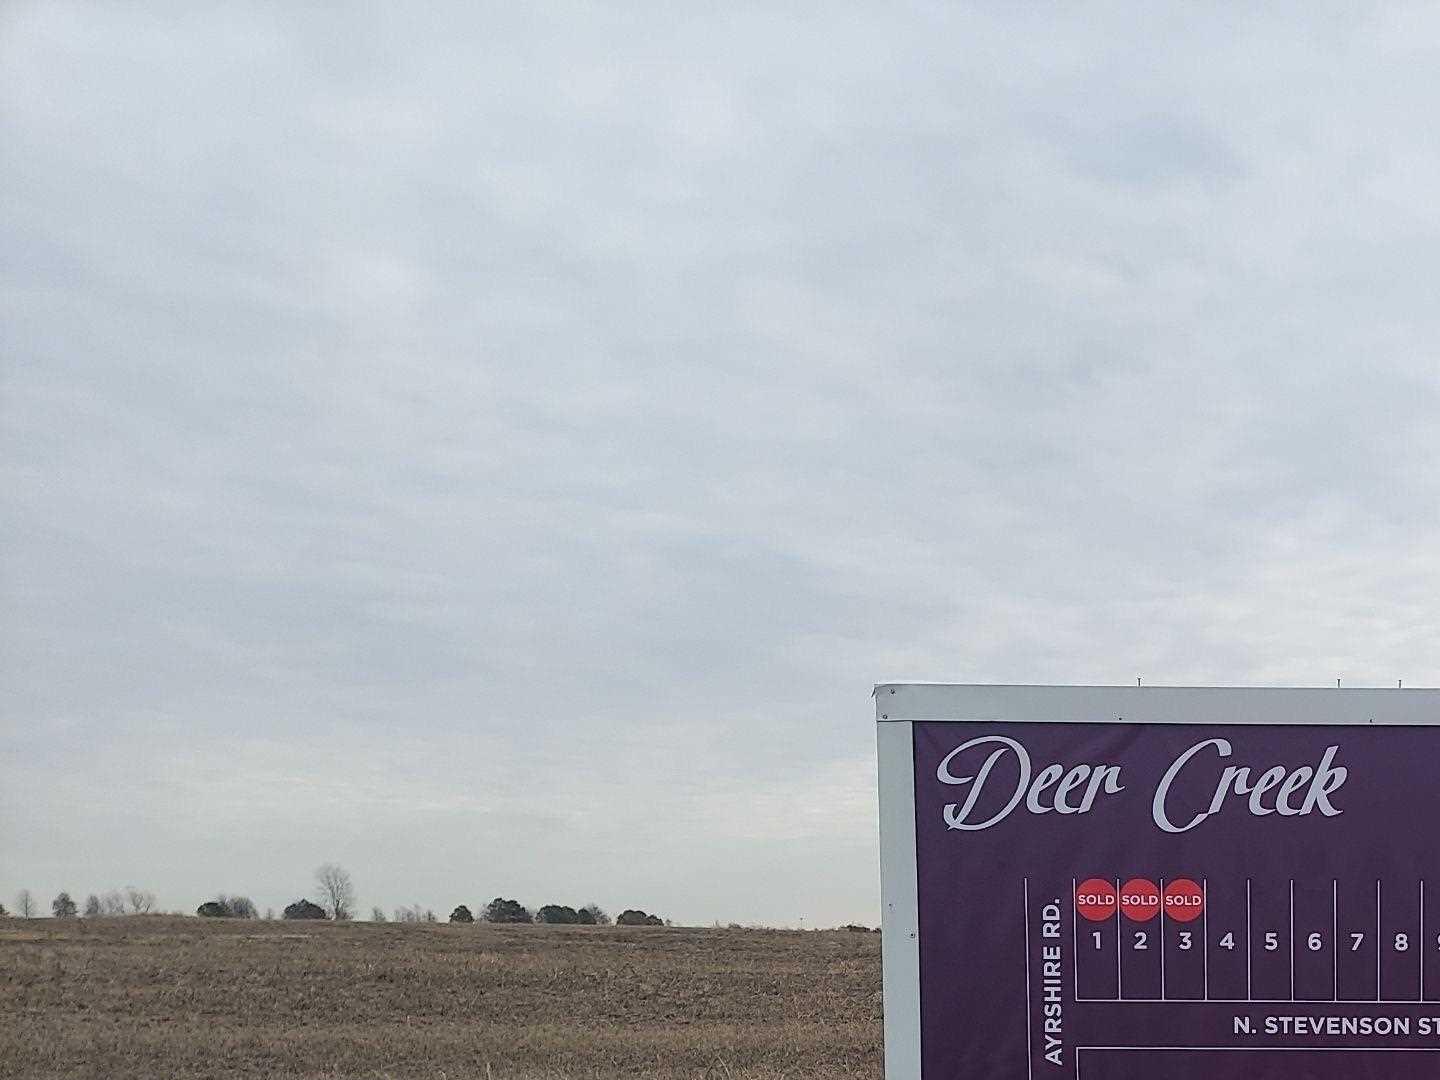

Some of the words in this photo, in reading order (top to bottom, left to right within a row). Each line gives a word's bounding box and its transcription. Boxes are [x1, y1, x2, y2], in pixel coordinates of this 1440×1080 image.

[937, 735, 1125, 831] Deer
[1151, 738, 1348, 833] Creek
[1077, 893, 1115, 906] SOLD
[1121, 893, 1158, 906] SOLD
[1164, 893, 1202, 906] SOLD
[1042, 898, 1061, 940] RD.
[1092, 932, 1102, 950] 1
[1133, 932, 1148, 950] 2
[1178, 932, 1192, 950] 3
[1219, 932, 1235, 950] 4
[1264, 932, 1278, 950] 5
[1307, 932, 1322, 950] 6
[1350, 933, 1364, 951] 7
[1394, 933, 1409, 951] 8
[1043, 947, 1063, 1067] AYRSHIRE
[1234, 1016, 1257, 1035] N.
[1264, 1016, 1410, 1036] STEVENSON
